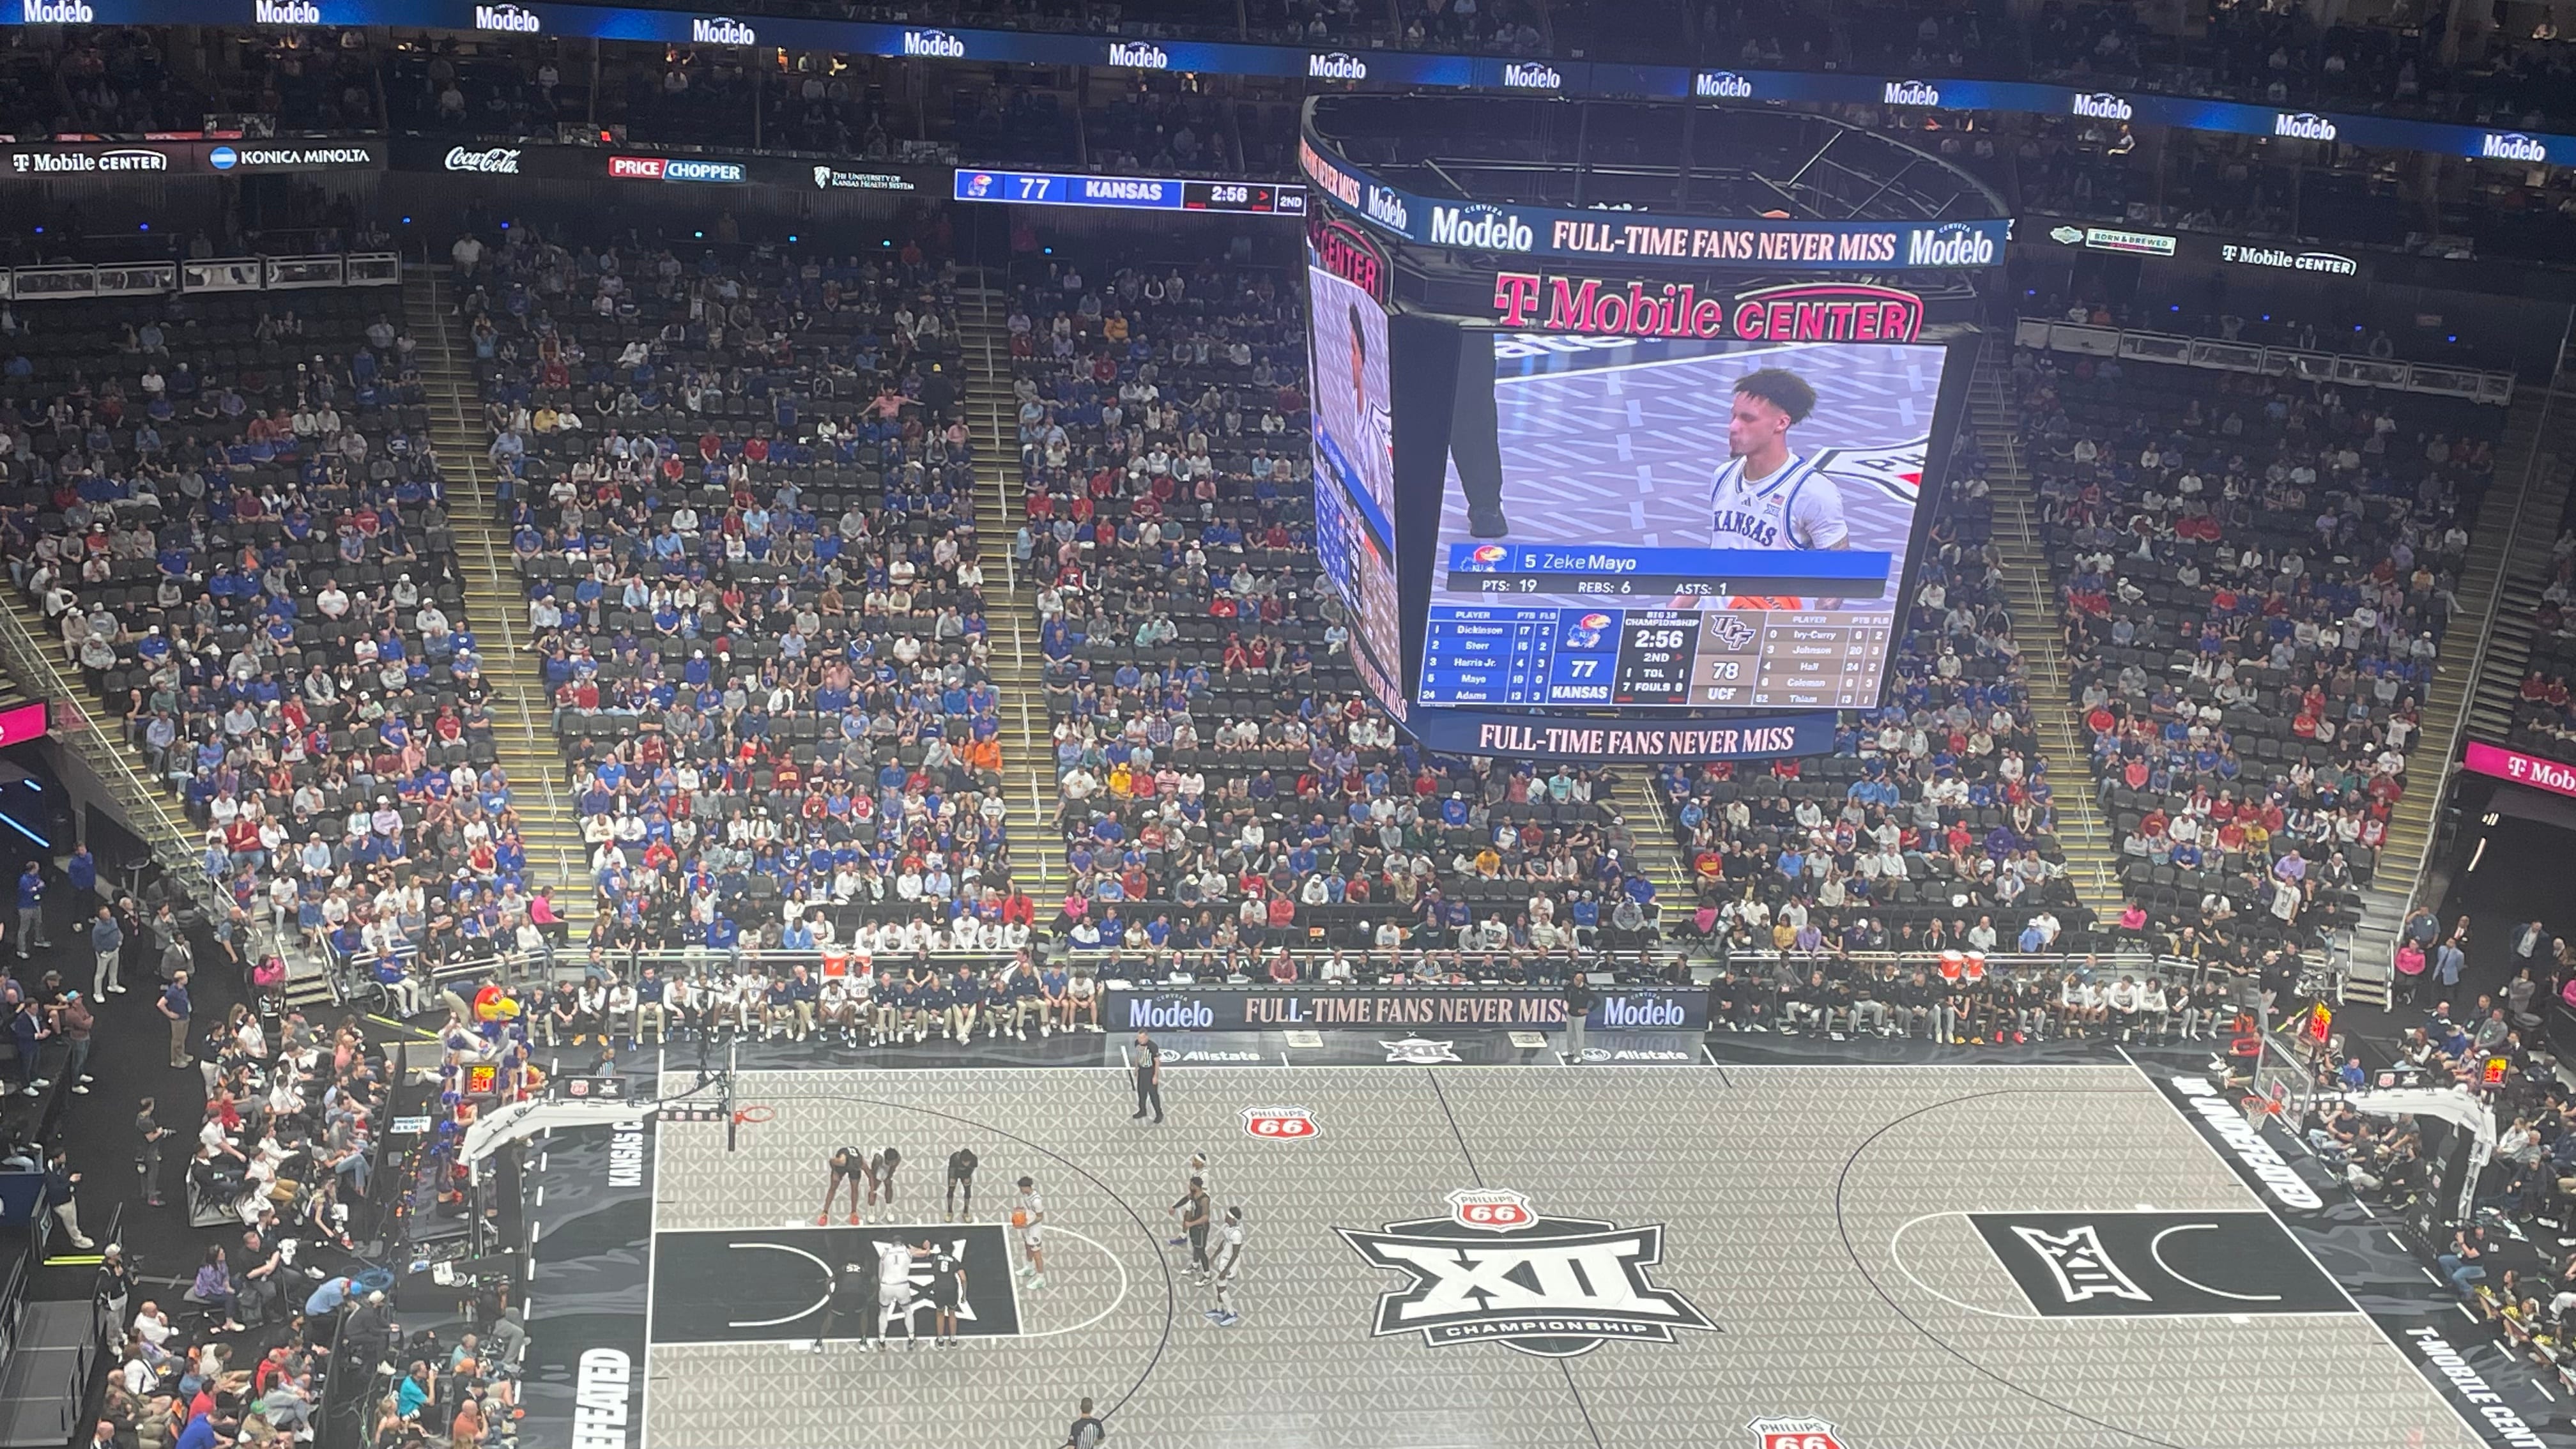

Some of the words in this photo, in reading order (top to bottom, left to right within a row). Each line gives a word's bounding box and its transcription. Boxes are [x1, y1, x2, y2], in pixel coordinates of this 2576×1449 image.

[24, 0, 93, 22] Modelo
[256, 0, 319, 24] Modelo
[475, 6, 539, 32] Modelo
[693, 19, 755, 45] Modelo
[904, 31, 964, 57] Modelo
[1109, 43, 1168, 69] Modelo
[1308, 54, 1367, 79] Modelo
[1505, 64, 1561, 89] Modelo
[1696, 73, 1751, 97] Modelo
[1884, 82, 1939, 105] Modelo
[2074, 93, 2132, 120] Modelo
[2276, 113, 2336, 141] Modelo
[241, 151, 300, 164] KONICA
[304, 150, 370, 164] MINOLTA
[2483, 134, 2547, 162] Modelo
[13, 155, 29, 172] T
[34, 153, 95, 171] Mobile
[98, 155, 160, 170] CENTER
[615, 160, 659, 176] PRICE
[668, 163, 740, 180] CHOPPER
[1020, 178, 1051, 199] 77
[1085, 181, 1162, 201] KANSAS
[1211, 186, 1248, 202] 2:56
[1280, 197, 1302, 208] 2ND
[1368, 185, 1406, 230] Modelo
[1431, 206, 1533, 252] Modelo
[1552, 220, 1689, 257] FULL-TIME
[1692, 229, 1754, 261] FANS
[1758, 232, 1836, 261] NEVER
[1837, 234, 1897, 261] MISS
[1908, 229, 1993, 265] Modelo
[2222, 245, 2237, 261] T
[2239, 247, 2292, 268] Mobile
[2296, 257, 2352, 274] CENTER
[1494, 272, 1540, 326] T
[1544, 275, 1722, 339] Mobile
[1734, 301, 1908, 341] CENTER
[1713, 510, 1777, 547] KANSAS
[1525, 555, 1537, 568] 5
[1543, 554, 1585, 569] Zeke
[1588, 555, 1637, 574] Mayo
[1482, 580, 1510, 591] PTS:
[1519, 580, 1537, 592] 19
[1578, 582, 1614, 594] REBS:
[1621, 581, 1630, 594] 6
[1675, 584, 1712, 595] ASTS:
[1720, 583, 1726, 595] 1
[1457, 625, 1503, 634] Dickinson
[1542, 627, 1549, 635] 2
[1635, 630, 1683, 648] 2:56
[1712, 615, 1756, 650] UCF
[1794, 631, 1836, 641] Ivy-Curry
[1432, 641, 1439, 650] 2
[1538, 643, 1546, 651] 2
[1793, 646, 1832, 654] Johnson
[1429, 657, 1437, 666] 3
[1453, 658, 1482, 666] Harris
[1484, 659, 1496, 667] Jr.
[1516, 659, 1524, 668] 4
[1538, 659, 1545, 668] 3
[1643, 653, 1669, 662] 2ND
[1763, 662, 1771, 670] 4
[1869, 663, 1876, 671] 2
[1572, 661, 1598, 677] 77
[1626, 668, 1631, 677] 1
[1643, 669, 1664, 678] TOL
[1678, 670, 1683, 678] 1
[1713, 663, 1738, 679] 78
[1461, 674, 1487, 685] Mayo
[1623, 682, 1630, 691] 7
[1635, 683, 1670, 692] FOULS
[1866, 679, 1873, 687] 3
[1422, 691, 1436, 700] 24
[1455, 691, 1487, 700] Adams
[1511, 692, 1521, 700] 13
[1533, 692, 1540, 701] 3
[1552, 686, 1608, 699] KANSAS
[1708, 687, 1736, 700] UCF
[1385, 684, 1407, 723] MISS
[1479, 723, 1606, 753] FULL-TIME
[1607, 728, 1664, 755] FANS
[1668, 729, 1739, 755] NEVER
[1742, 726, 1795, 752] MISS
[2508, 756, 2527, 778] T
[2529, 762, 2576, 792] Mob
[1130, 999, 1213, 1027] Modelo
[1245, 998, 1370, 1023] FULL-TIME
[1376, 998, 1433, 1023] FANS
[1438, 998, 1515, 1023] NEVER
[1604, 997, 1685, 1025] Modelo
[1183, 1050, 1261, 1061] Allstate
[1614, 1050, 1689, 1060] Allstate
[1258, 1120, 1303, 1134] 66
[608, 1133, 643, 1186] KANSAS
[2189, 1097, 2323, 1209] UNDEFEATED
[1471, 1206, 1516, 1221] 66
[1446, 1321, 1648, 1338] CHAMPIONSHIP
[2406, 1326, 2503, 1404] T-MOBILE
[1760, 1423, 1824, 1432] PHILLIPS
